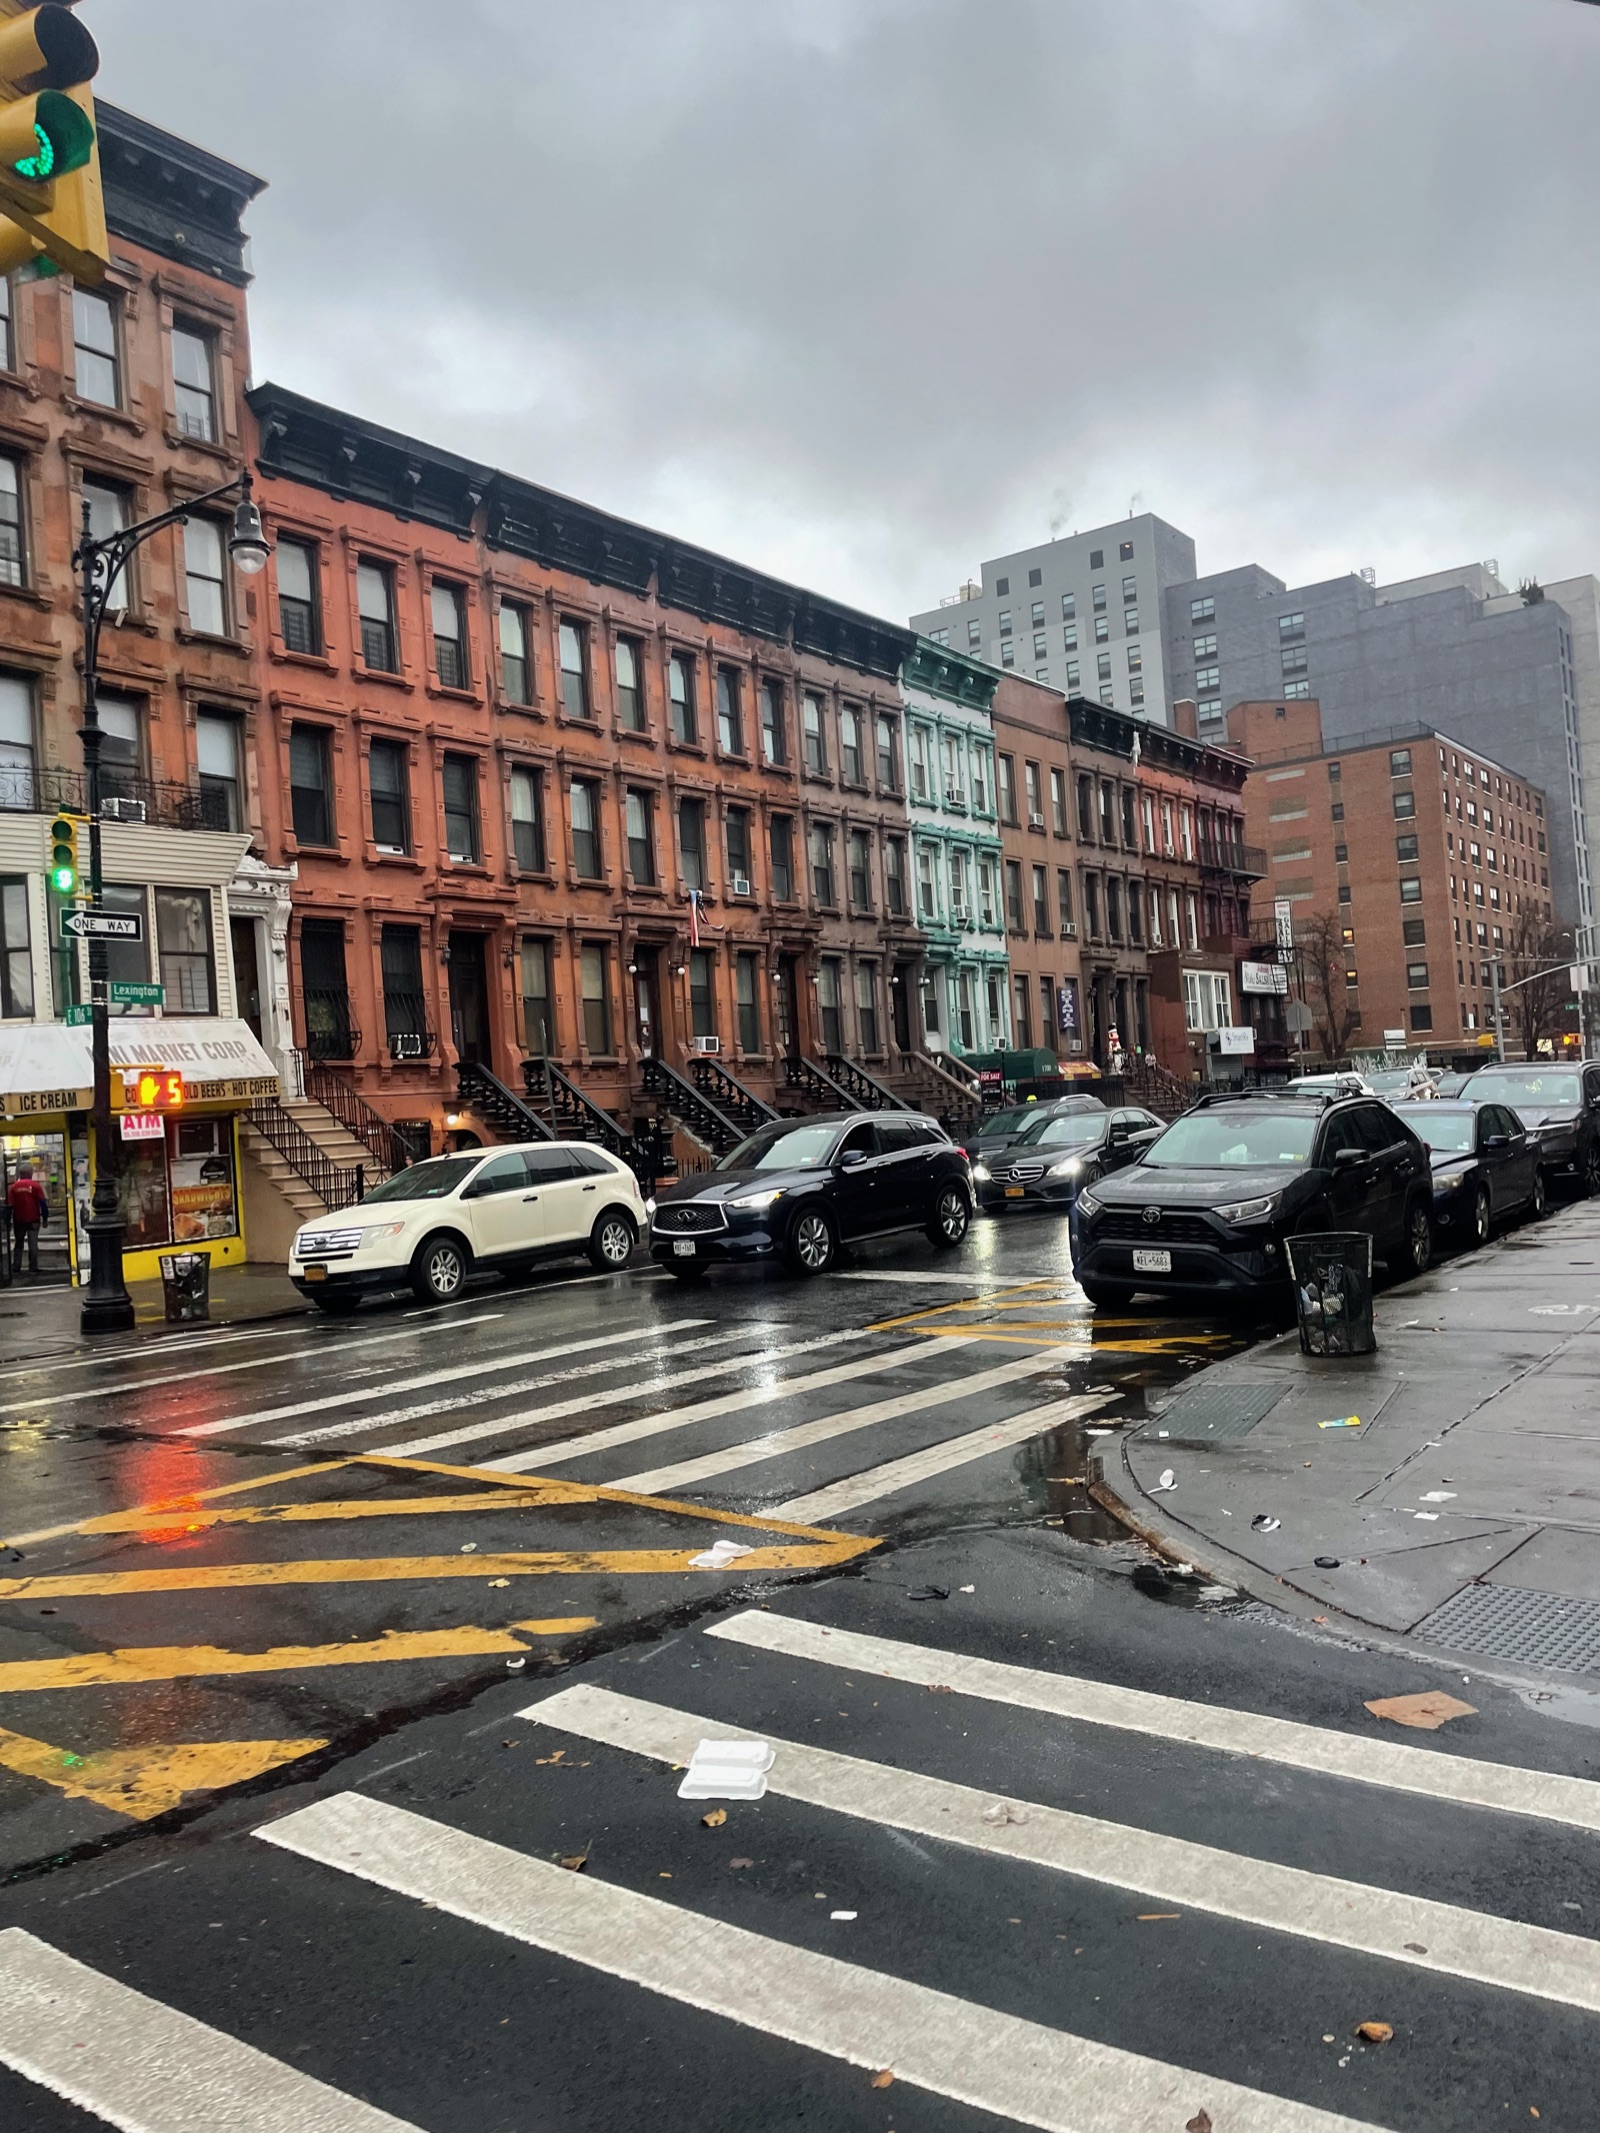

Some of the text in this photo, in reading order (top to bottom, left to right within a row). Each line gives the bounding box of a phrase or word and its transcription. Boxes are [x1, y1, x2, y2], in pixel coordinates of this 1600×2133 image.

[73, 919, 131, 932] ONE WAY
[113, 984, 159, 999] Lexington
[67, 1009, 72, 1024] E
[74, 1007, 86, 1023] 106
[1060, 989, 1075, 1028] BOTANICA
[130, 1042, 201, 1063] MARKET
[200, 1083, 226, 1098] BEERS
[232, 1081, 247, 1096] HOT
[249, 1079, 277, 1095] COFFEE
[19, 1095, 37, 1111] ICE
[40, 1092, 77, 1109] CREAM
[123, 1115, 161, 1130] ATM
